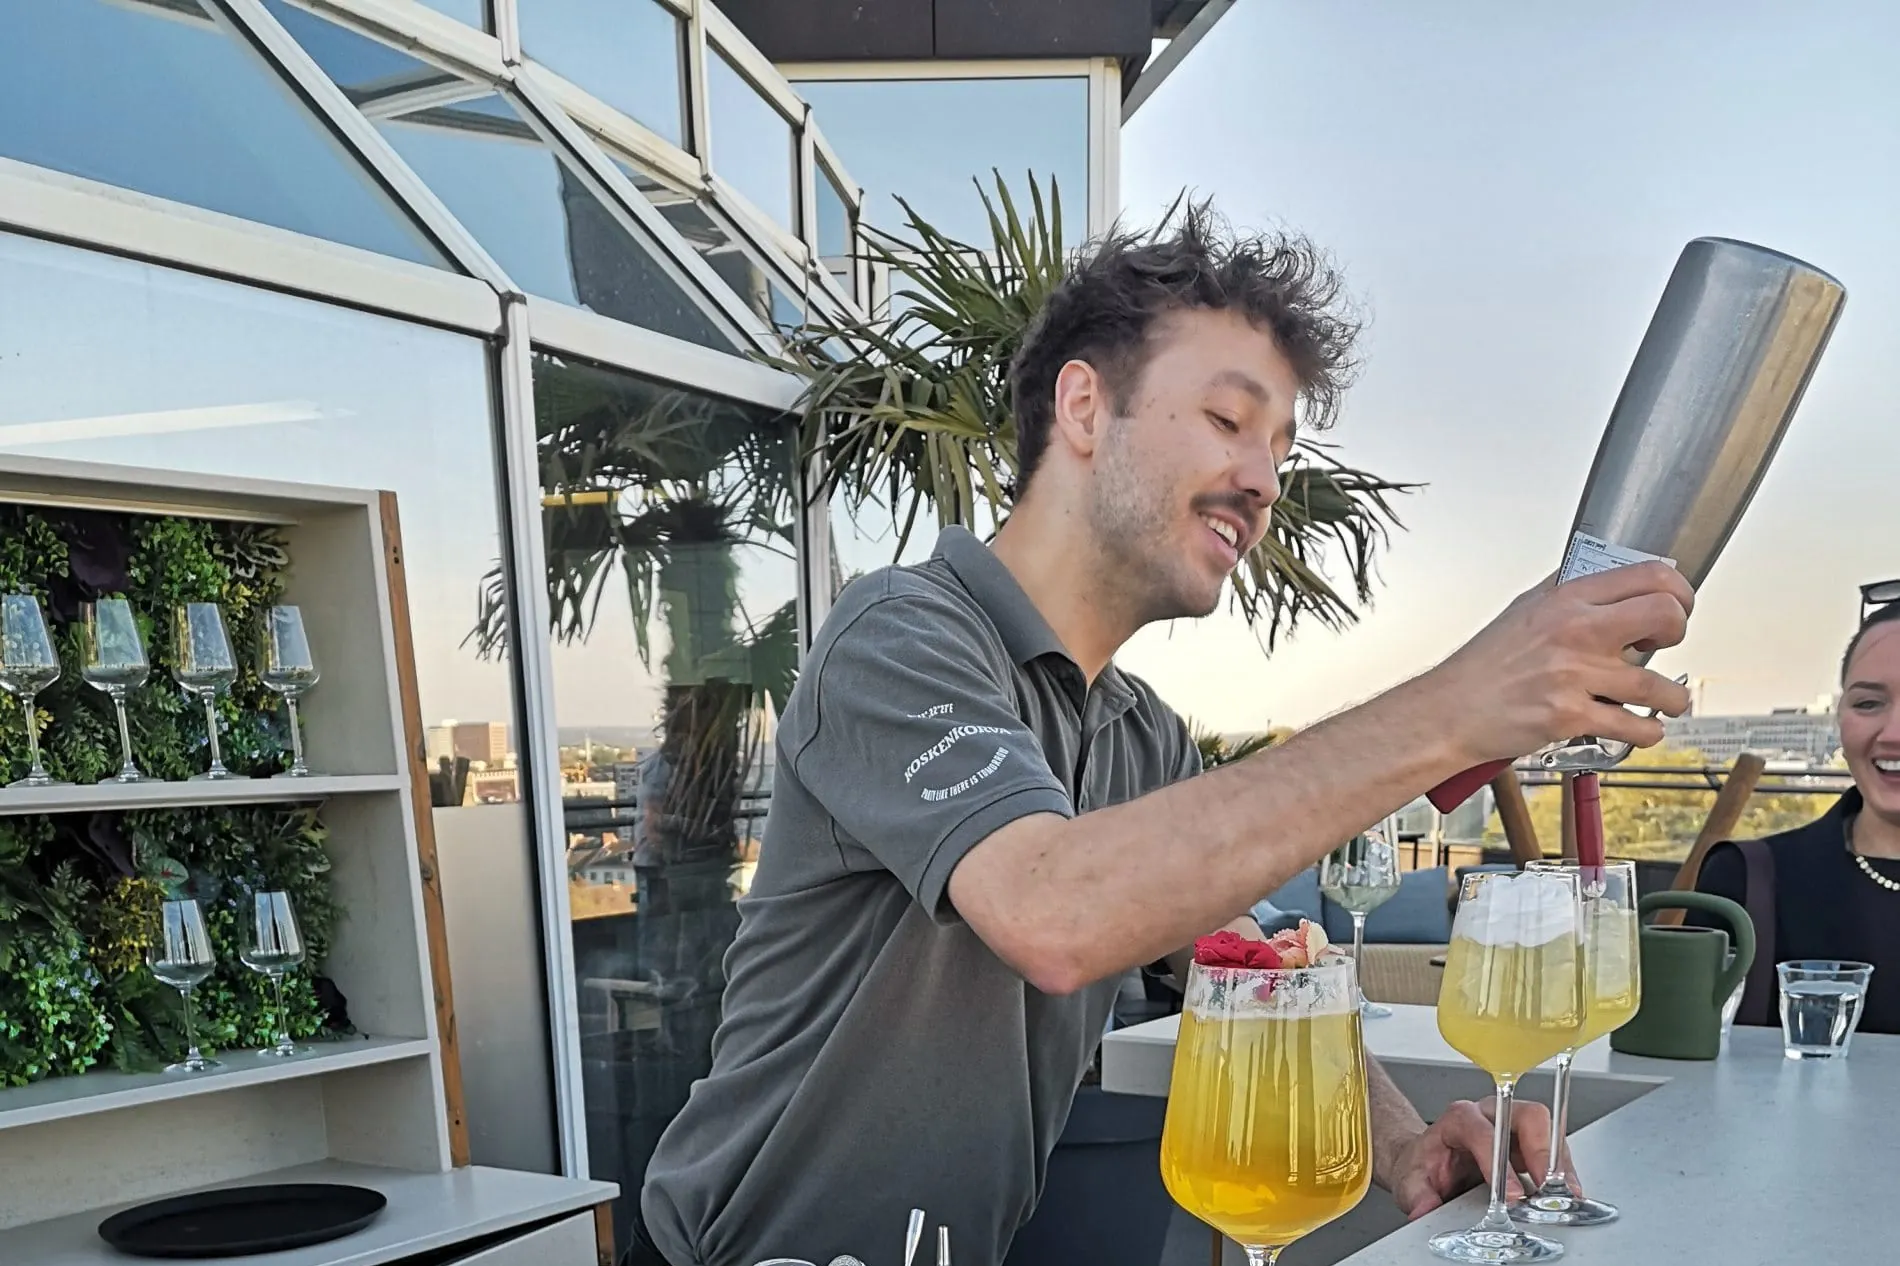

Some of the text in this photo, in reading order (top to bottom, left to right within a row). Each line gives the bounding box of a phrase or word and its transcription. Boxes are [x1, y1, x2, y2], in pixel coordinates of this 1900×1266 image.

[904, 725, 1012, 783] KOSKENKORVA
[950, 779, 970, 797] THERE
[969, 774, 979, 786] IS
